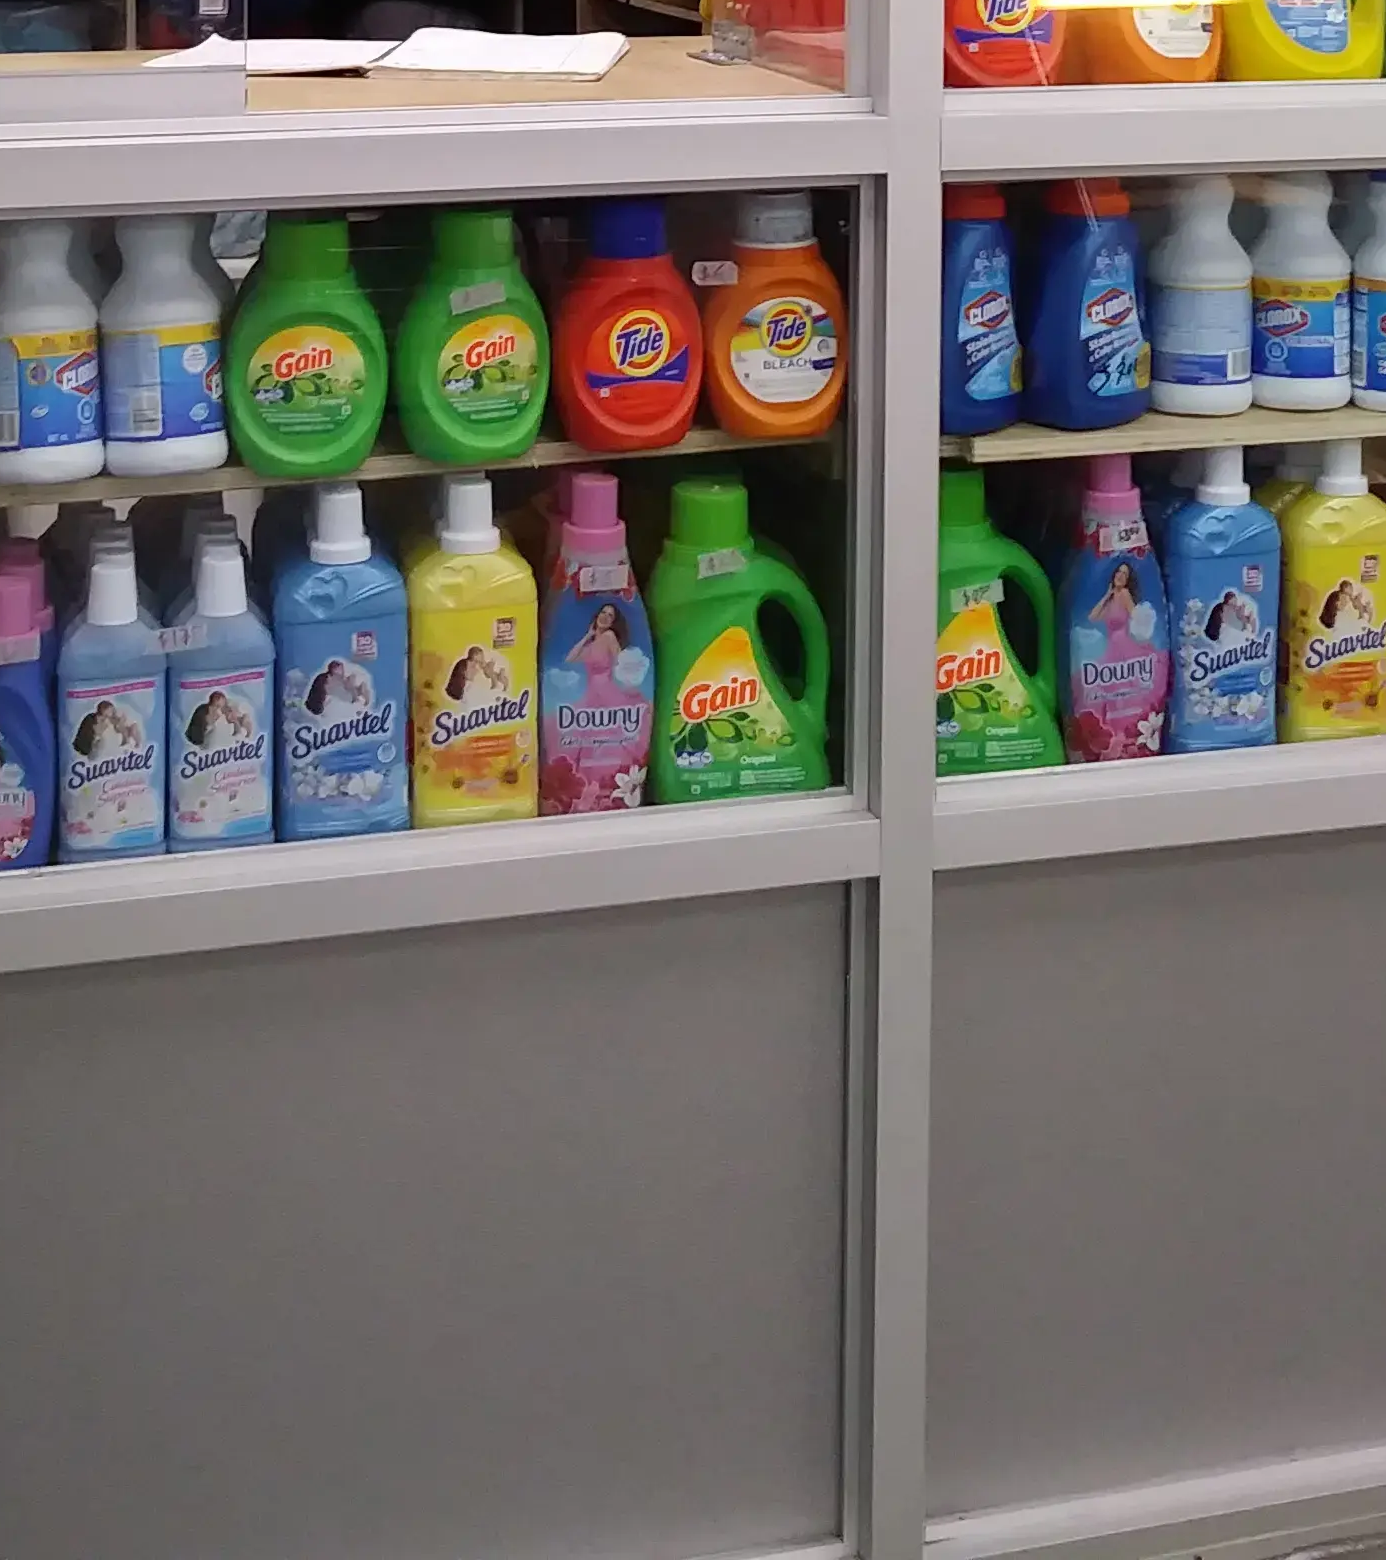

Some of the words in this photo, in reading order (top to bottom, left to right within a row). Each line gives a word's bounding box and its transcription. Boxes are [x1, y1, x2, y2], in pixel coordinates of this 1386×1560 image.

[464, 334, 517, 371] Gain
[615, 324, 665, 367] Tide
[766, 316, 807, 348] Tide
[274, 347, 334, 380] Gain
[762, 357, 812, 370] BLEACH
[935, 648, 1002, 692] Gain
[1083, 654, 1154, 687] Downy
[1190, 630, 1273, 682] Suavitel
[430, 690, 530, 746] Suavitel
[558, 704, 642, 733] Downy
[682, 674, 760, 723] Gain
[291, 703, 393, 760] Suavitel
[67, 743, 155, 790] Suavitel
[180, 733, 265, 780] Suavitel
